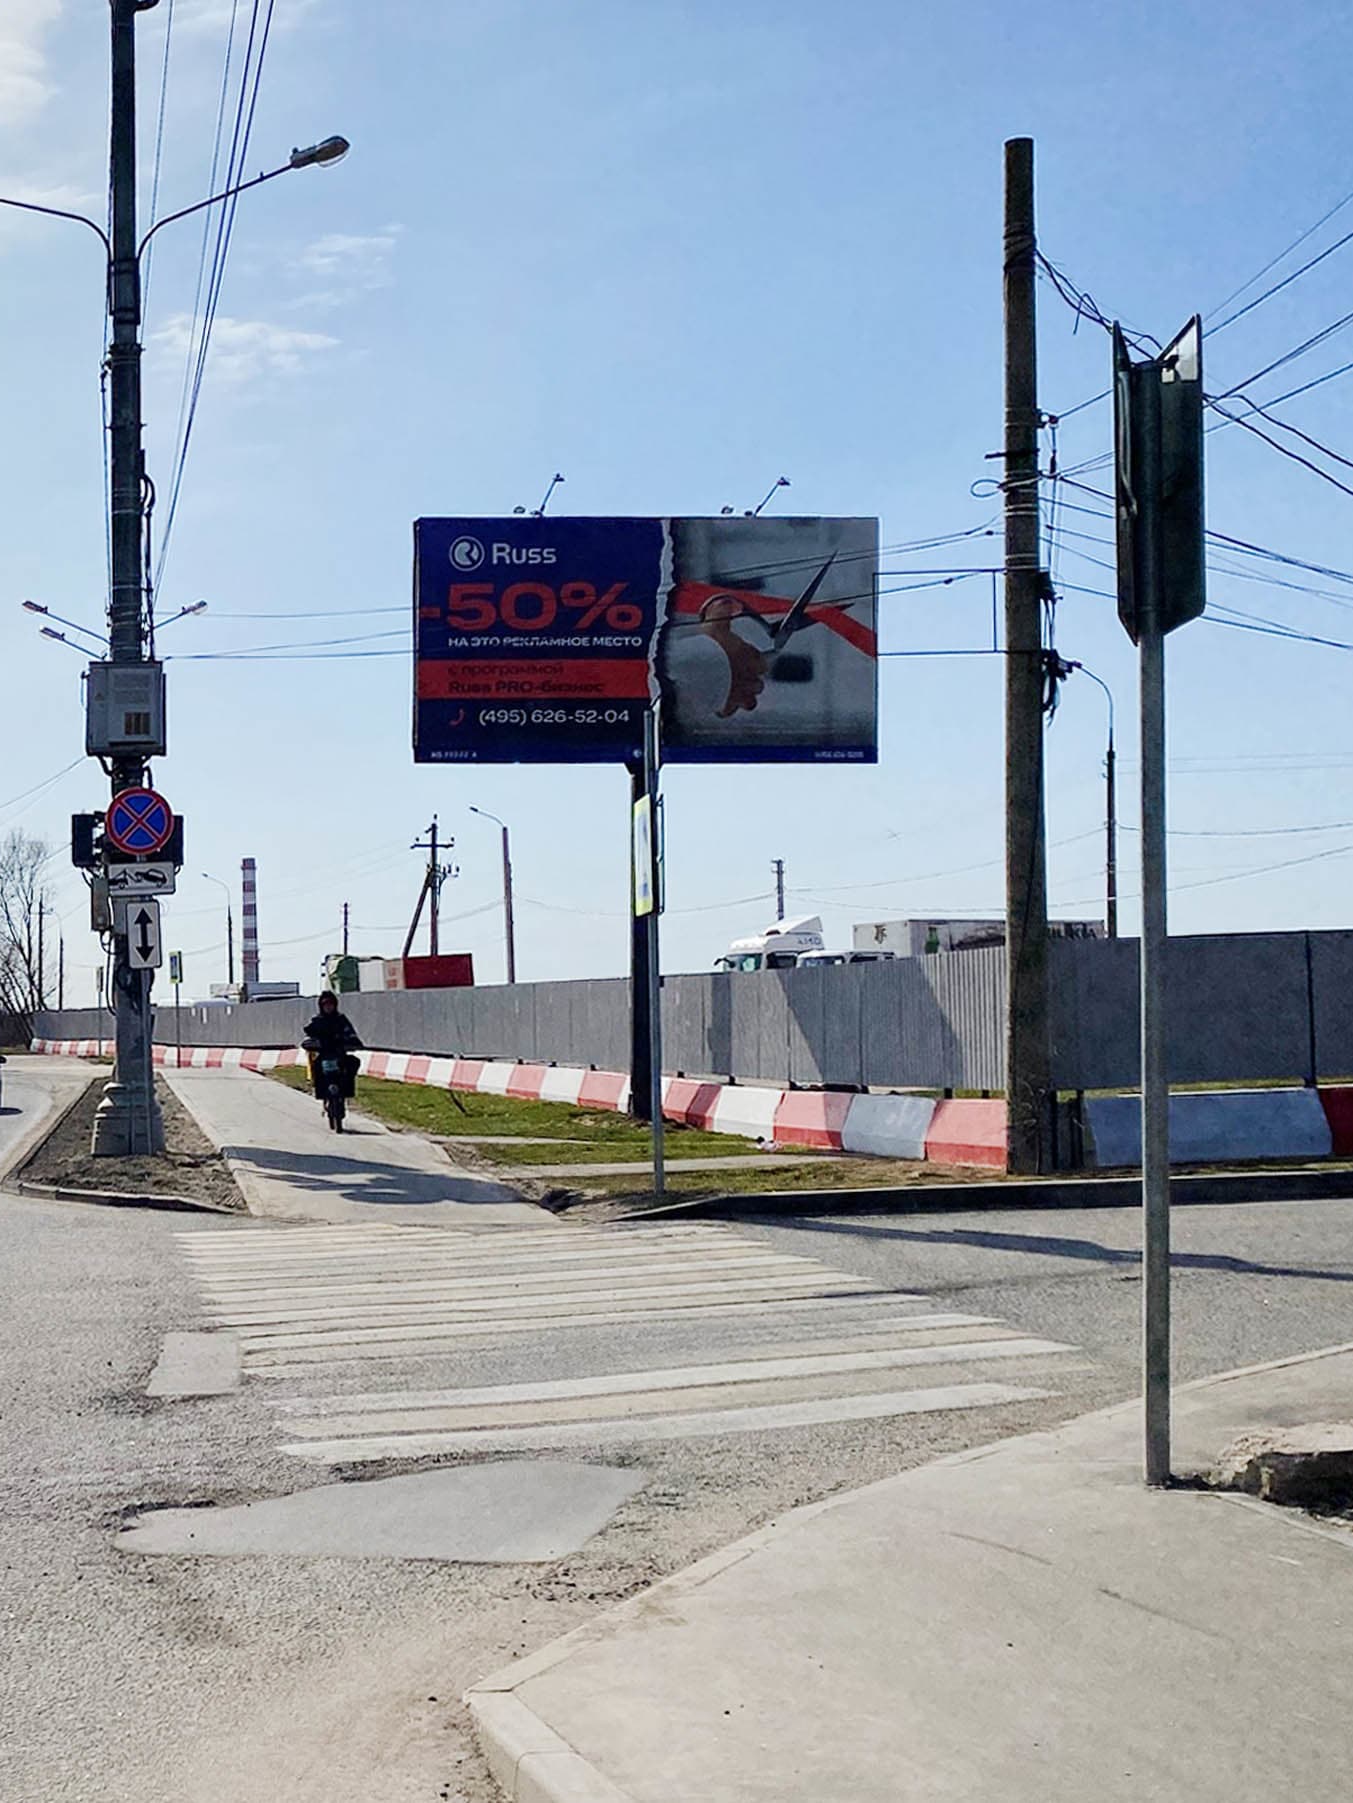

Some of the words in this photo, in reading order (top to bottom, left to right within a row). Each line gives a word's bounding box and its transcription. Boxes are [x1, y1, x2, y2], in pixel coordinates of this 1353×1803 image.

[492, 542, 557, 565] Russ
[419, 581, 643, 631] -50%
[448, 636, 468, 647] НА
[471, 636, 500, 647] ЭТО
[503, 636, 590, 647] РЕКЛАМНОЕ
[593, 636, 642, 647] МЕСТО
[479, 709, 527, 726] (495)
[530, 709, 630, 723] 626-52-04
